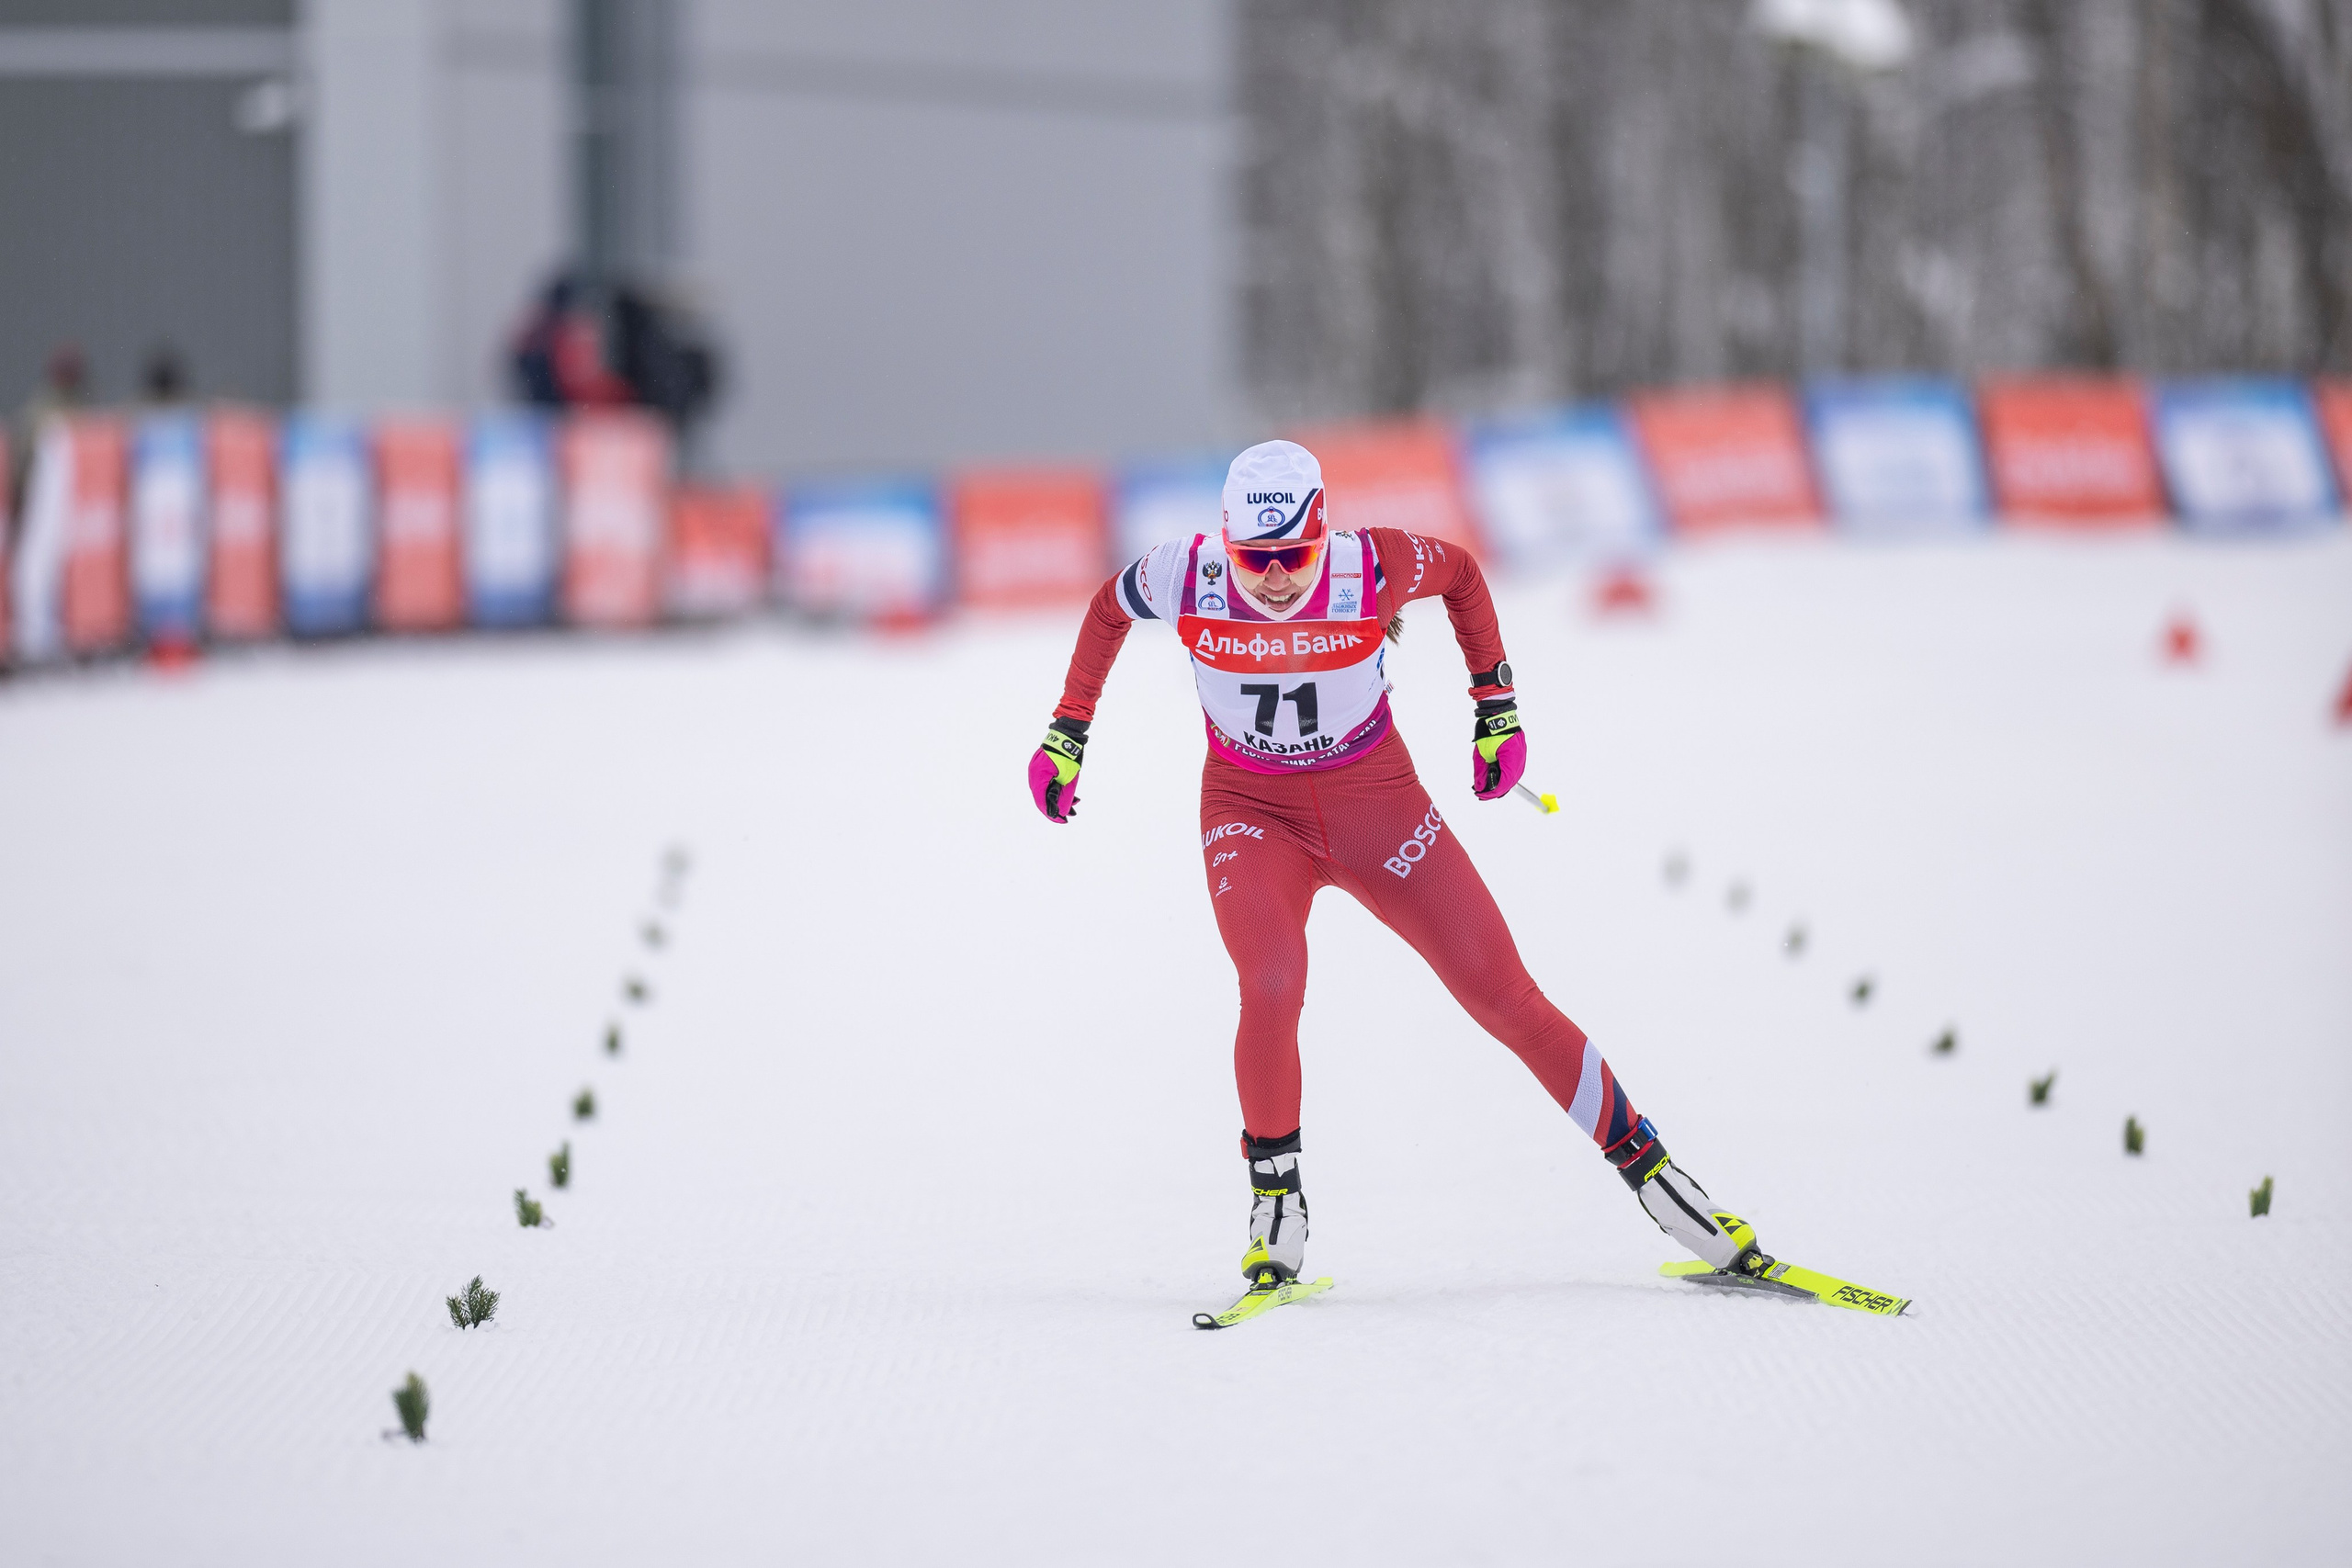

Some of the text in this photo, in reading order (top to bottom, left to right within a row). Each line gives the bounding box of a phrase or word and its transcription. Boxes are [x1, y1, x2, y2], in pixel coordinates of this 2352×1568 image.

[1247, 492, 1295, 504] LUKOIL
[1195, 628, 1363, 661] Альфа Банк
[1240, 682, 1318, 738] 71
[1243, 731, 1334, 754] КАЗАНЬ
[1202, 822, 1265, 851] LUKOIL
[1383, 803, 1442, 879] BOSCO
[1831, 1285, 1894, 1313] FISCHER
